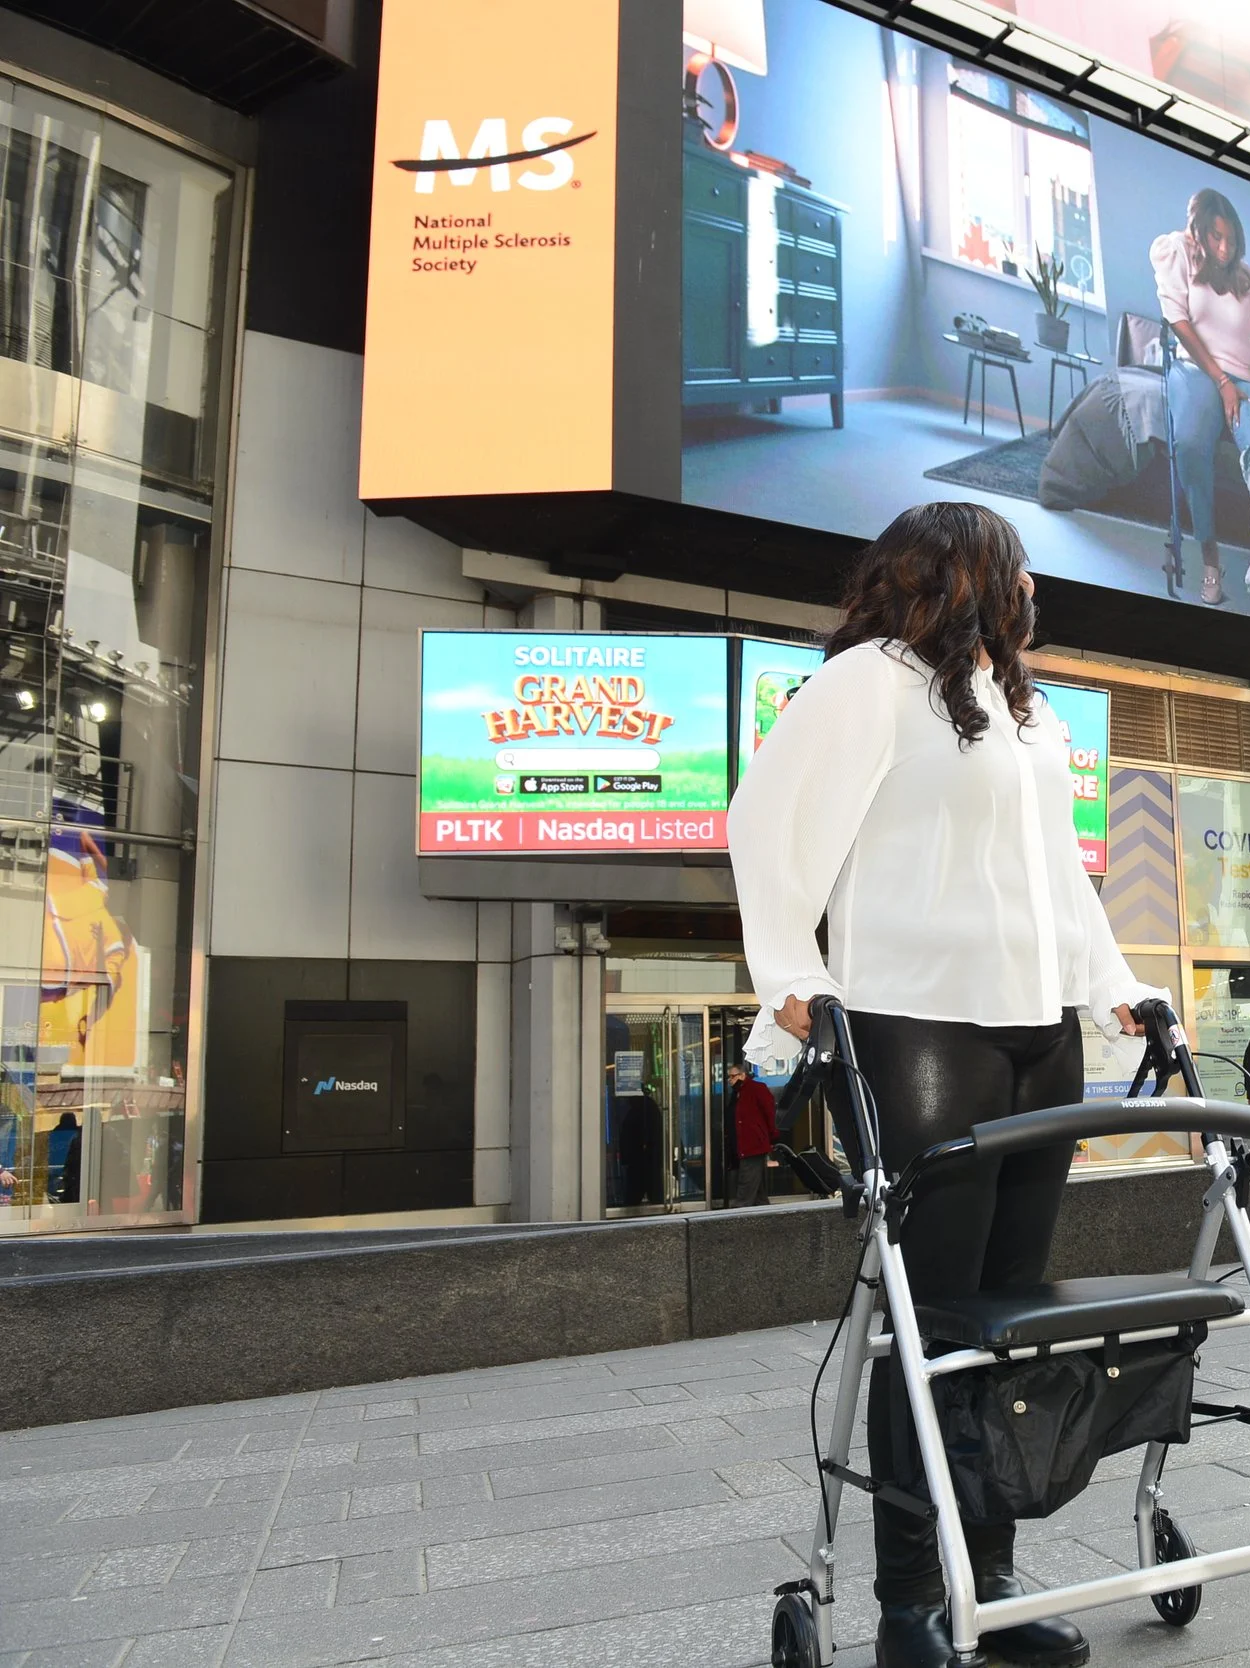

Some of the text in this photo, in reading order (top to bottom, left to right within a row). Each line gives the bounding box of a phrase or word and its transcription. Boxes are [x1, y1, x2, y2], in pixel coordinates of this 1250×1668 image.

[415, 117, 574, 193] MS
[414, 213, 491, 229] National
[413, 231, 571, 253] Multiple Sclerosis
[412, 257, 477, 275] Society
[514, 645, 646, 668] SOLITAIRE
[513, 674, 646, 706] GRAND
[481, 701, 675, 745] HARVEST
[540, 783, 584, 792] App Store
[613, 781, 658, 792] Google Play
[436, 816, 714, 844] PLTK Nasdaq Listed
[335, 1080, 378, 1092] Nasdaq
[1085, 1086, 1091, 1094] 4
[1092, 1086, 1114, 1094] TIMES
